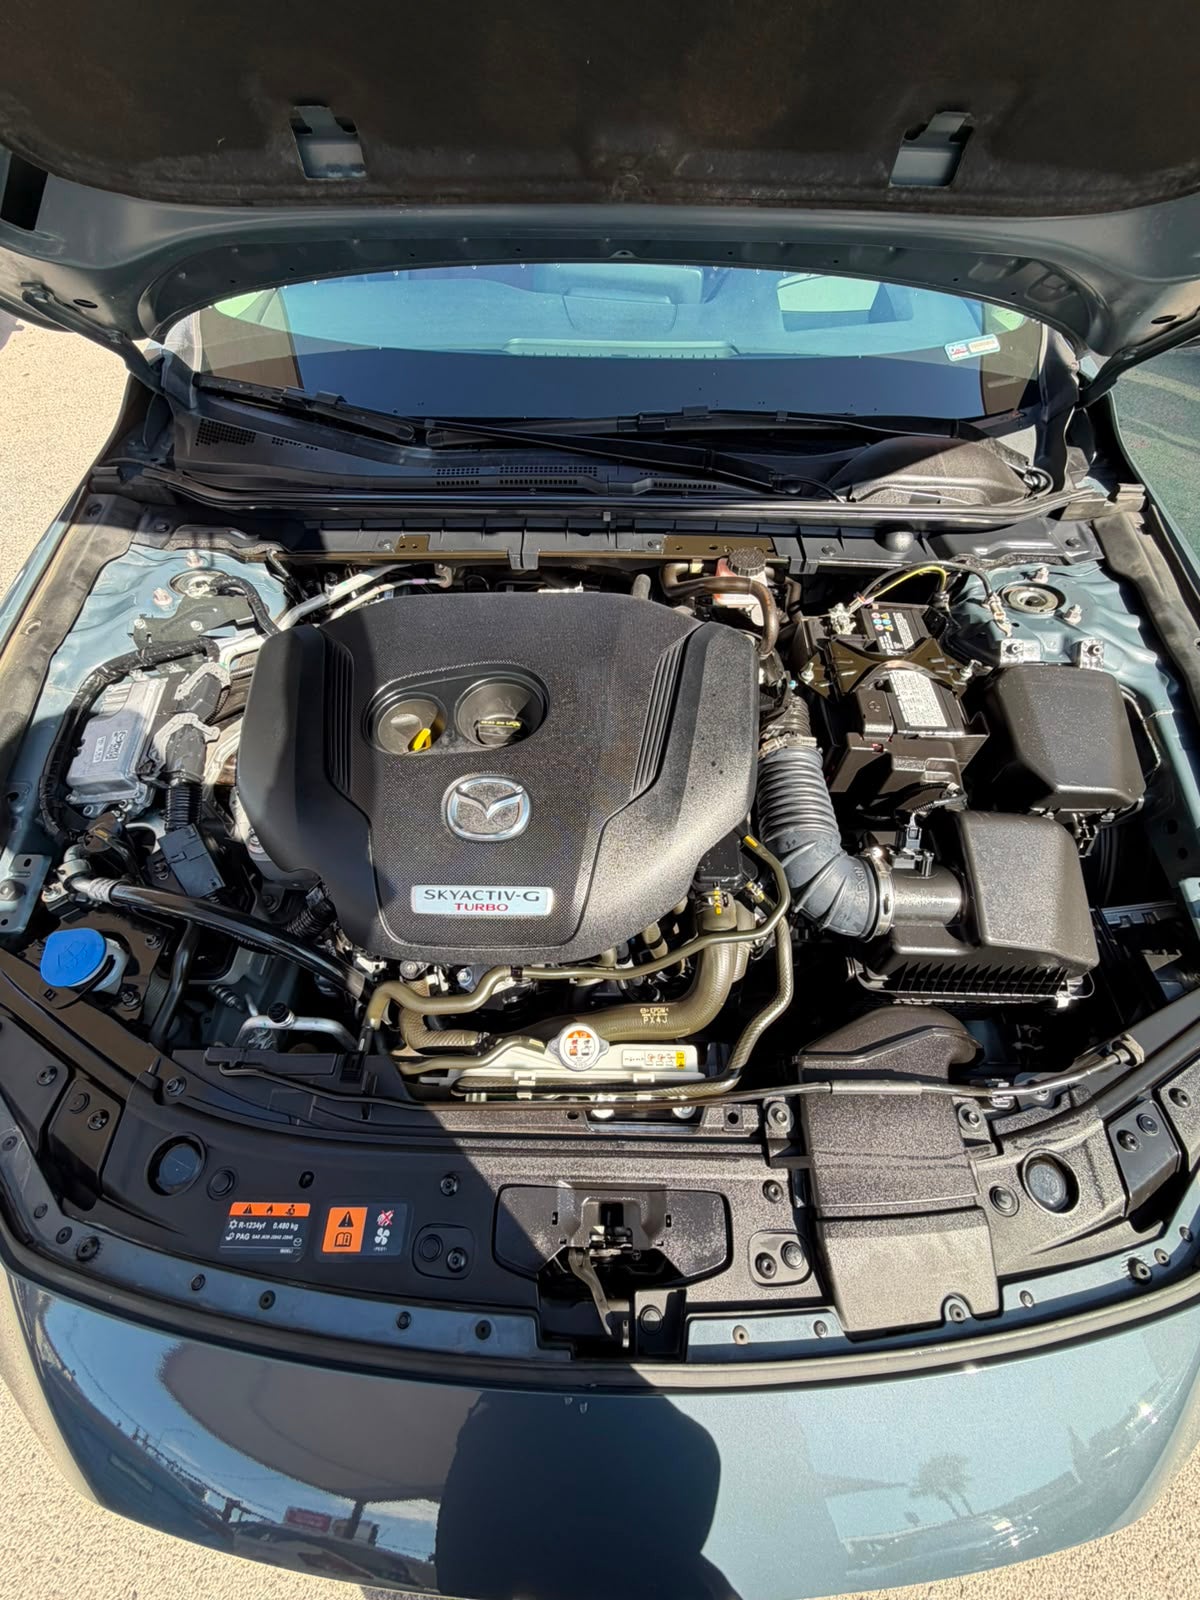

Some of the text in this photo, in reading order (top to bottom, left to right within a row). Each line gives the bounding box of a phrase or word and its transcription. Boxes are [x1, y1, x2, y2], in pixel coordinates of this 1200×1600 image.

[424, 889, 540, 902] SKYACTIV-G
[454, 903, 509, 912] TURBO
[643, 1016, 668, 1024] PX4J
[238, 1221, 299, 1231] R-1234yf 0.480 kg
